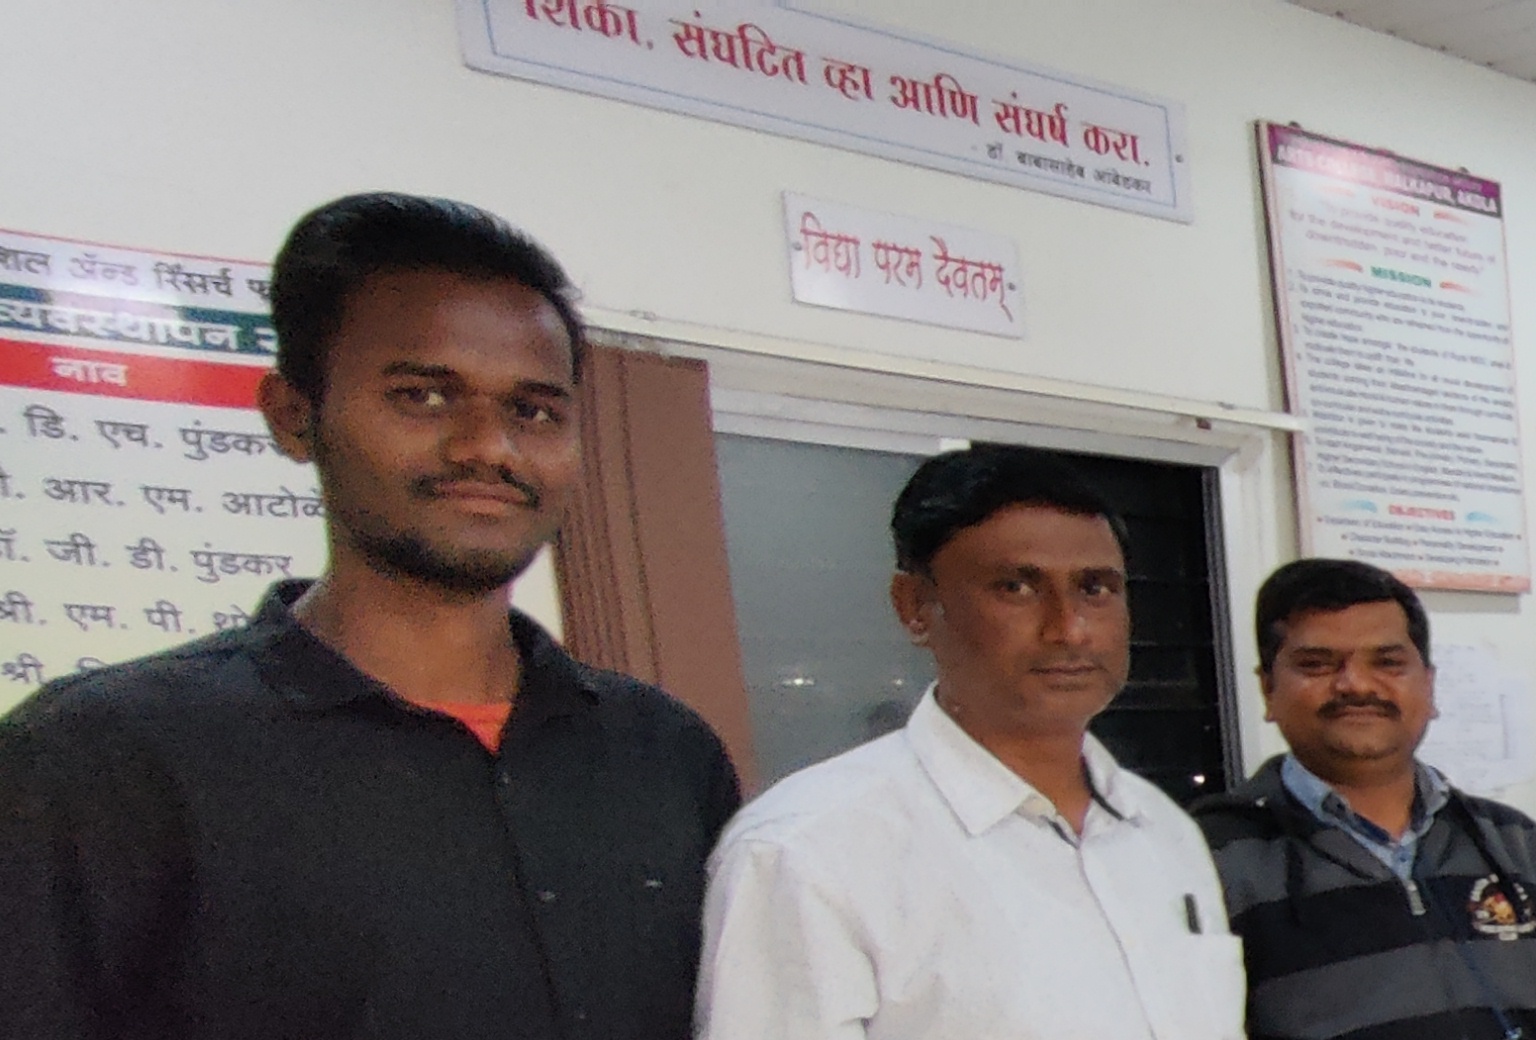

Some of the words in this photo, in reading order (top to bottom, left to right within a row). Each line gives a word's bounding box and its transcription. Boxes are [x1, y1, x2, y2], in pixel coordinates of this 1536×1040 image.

[668, 10, 808, 86] संघटित
[822, 57, 873, 100] व्हा
[889, 73, 980, 126] आणि
[991, 90, 1070, 148] संघर्ष
[1080, 121, 1150, 166] करा.
[872, 239, 921, 290] परम
[50, 356, 128, 387] नाव
[190, 542, 294, 583] पुंडकर
